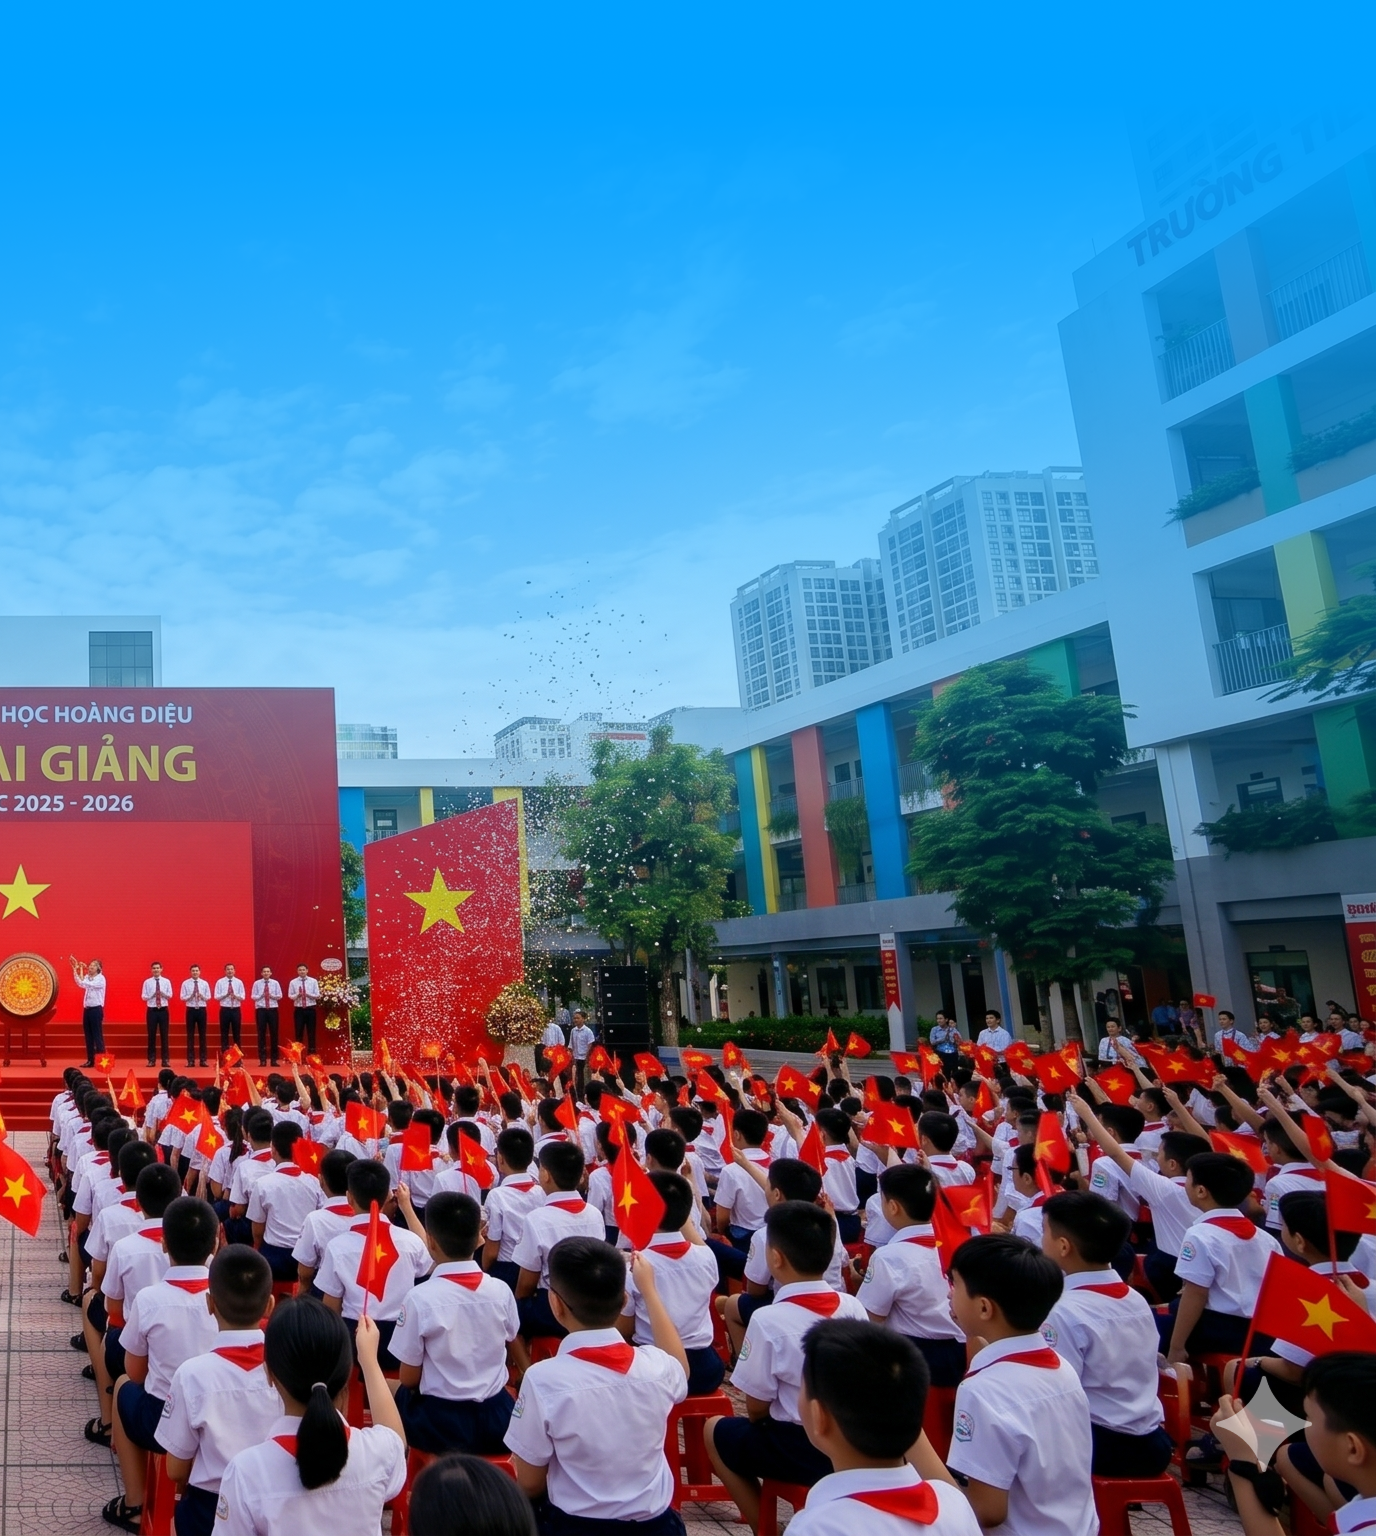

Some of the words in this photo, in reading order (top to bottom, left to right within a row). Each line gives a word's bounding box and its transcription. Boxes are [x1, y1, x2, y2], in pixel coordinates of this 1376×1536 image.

[1126, 141, 1284, 268] TRƯỜNG
[1, 705, 49, 729] HỌC
[54, 701, 136, 724] HOÀNG
[141, 702, 194, 729] DIỆU
[40, 733, 198, 783] GIẢNG
[13, 794, 65, 813] 2025
[82, 794, 134, 813] 2026
